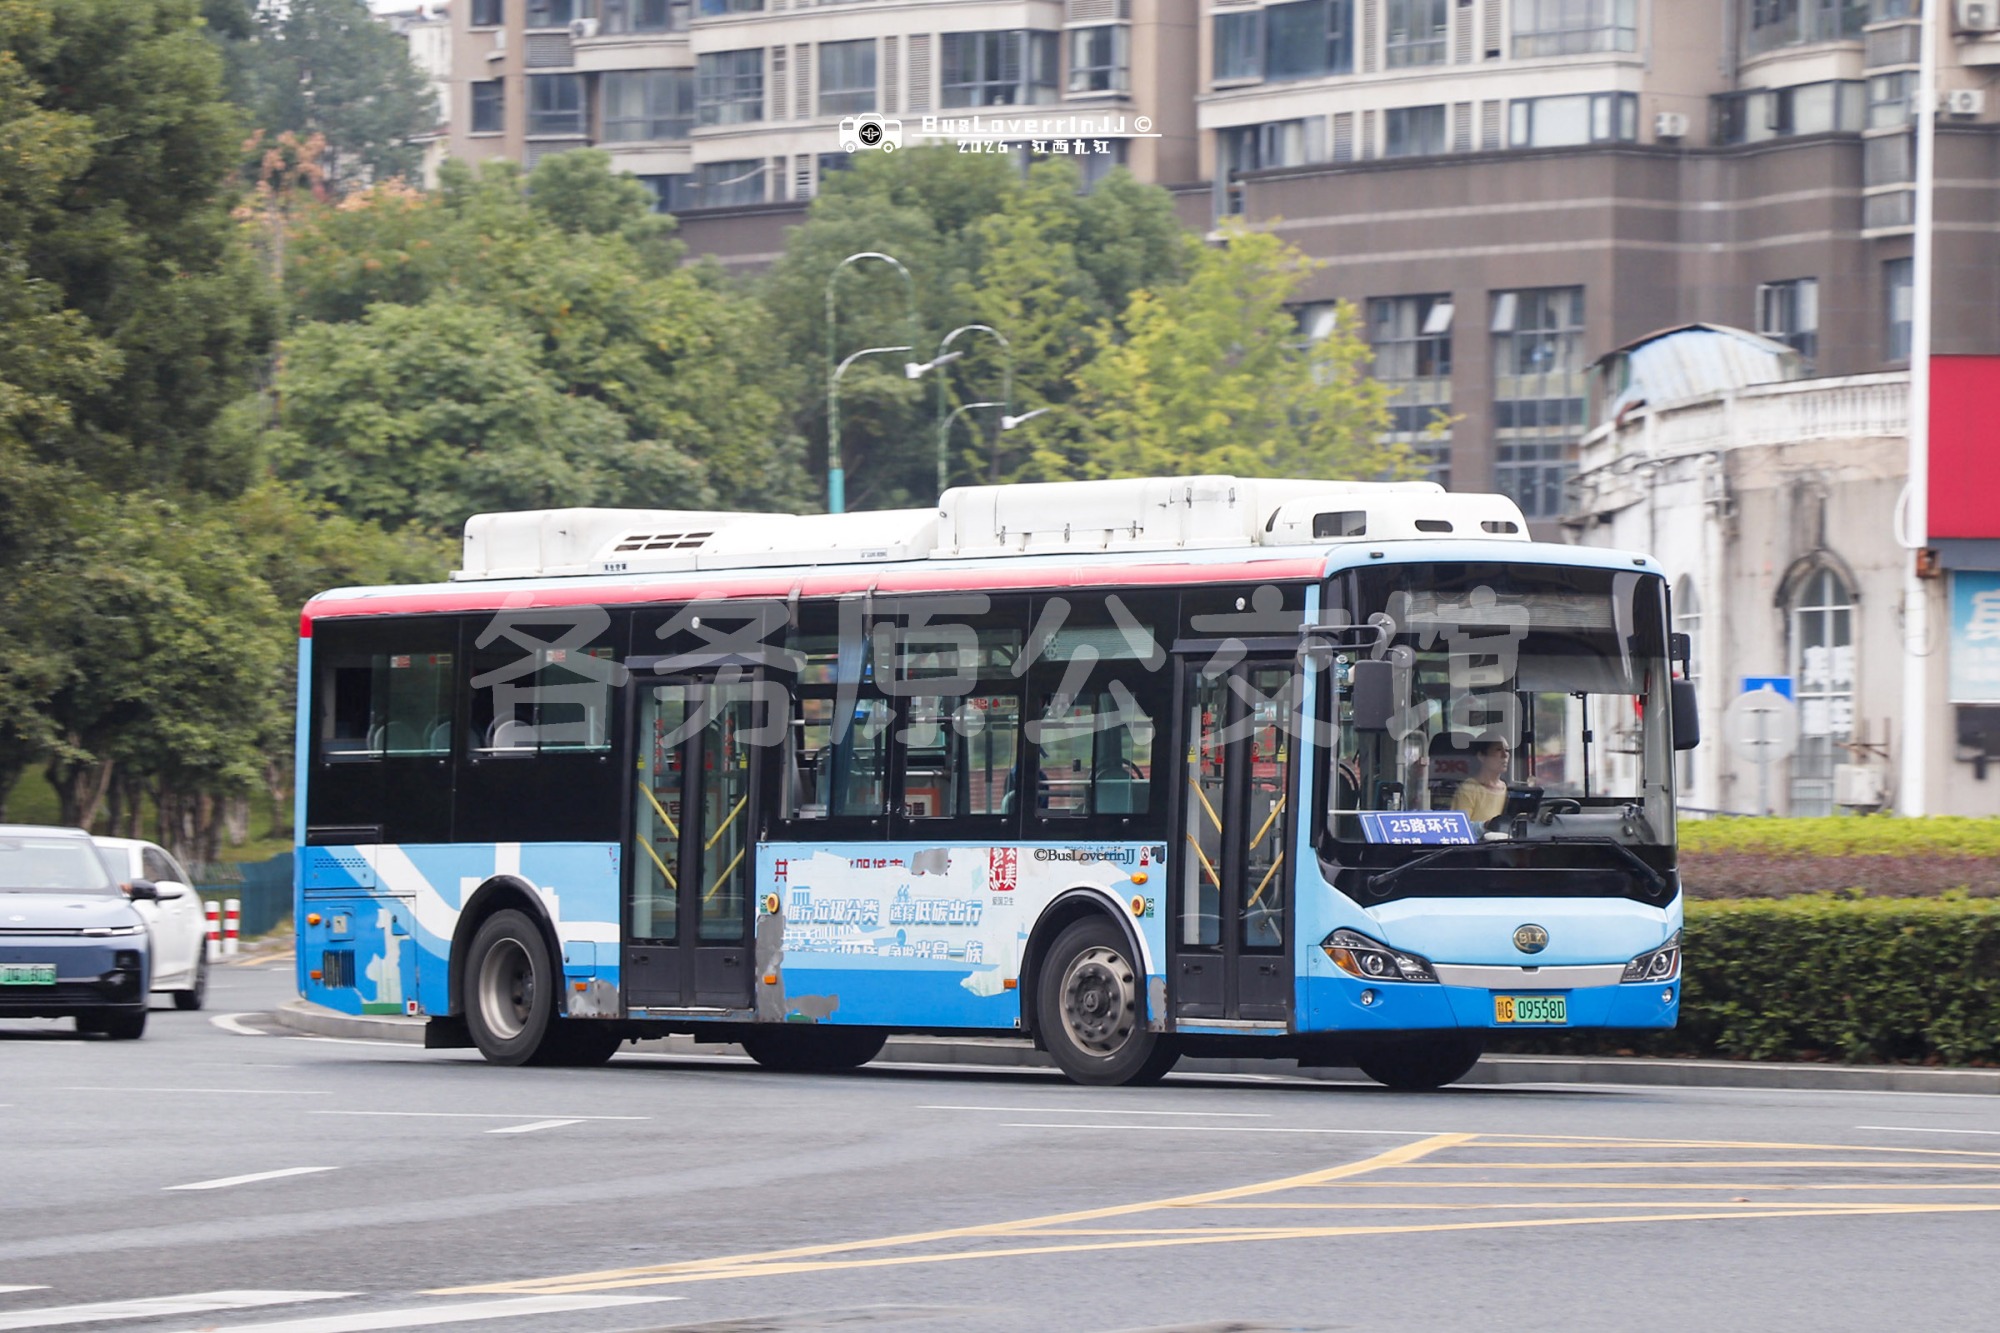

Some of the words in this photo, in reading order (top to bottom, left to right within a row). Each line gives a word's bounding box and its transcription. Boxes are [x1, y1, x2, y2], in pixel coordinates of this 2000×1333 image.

[1390, 818, 1459, 834] 25路环行
[788, 899, 879, 924] 推行垃圾分类
[889, 899, 983, 925] 选择低碳出行
[1518, 1000, 1565, 1019] 09558D
